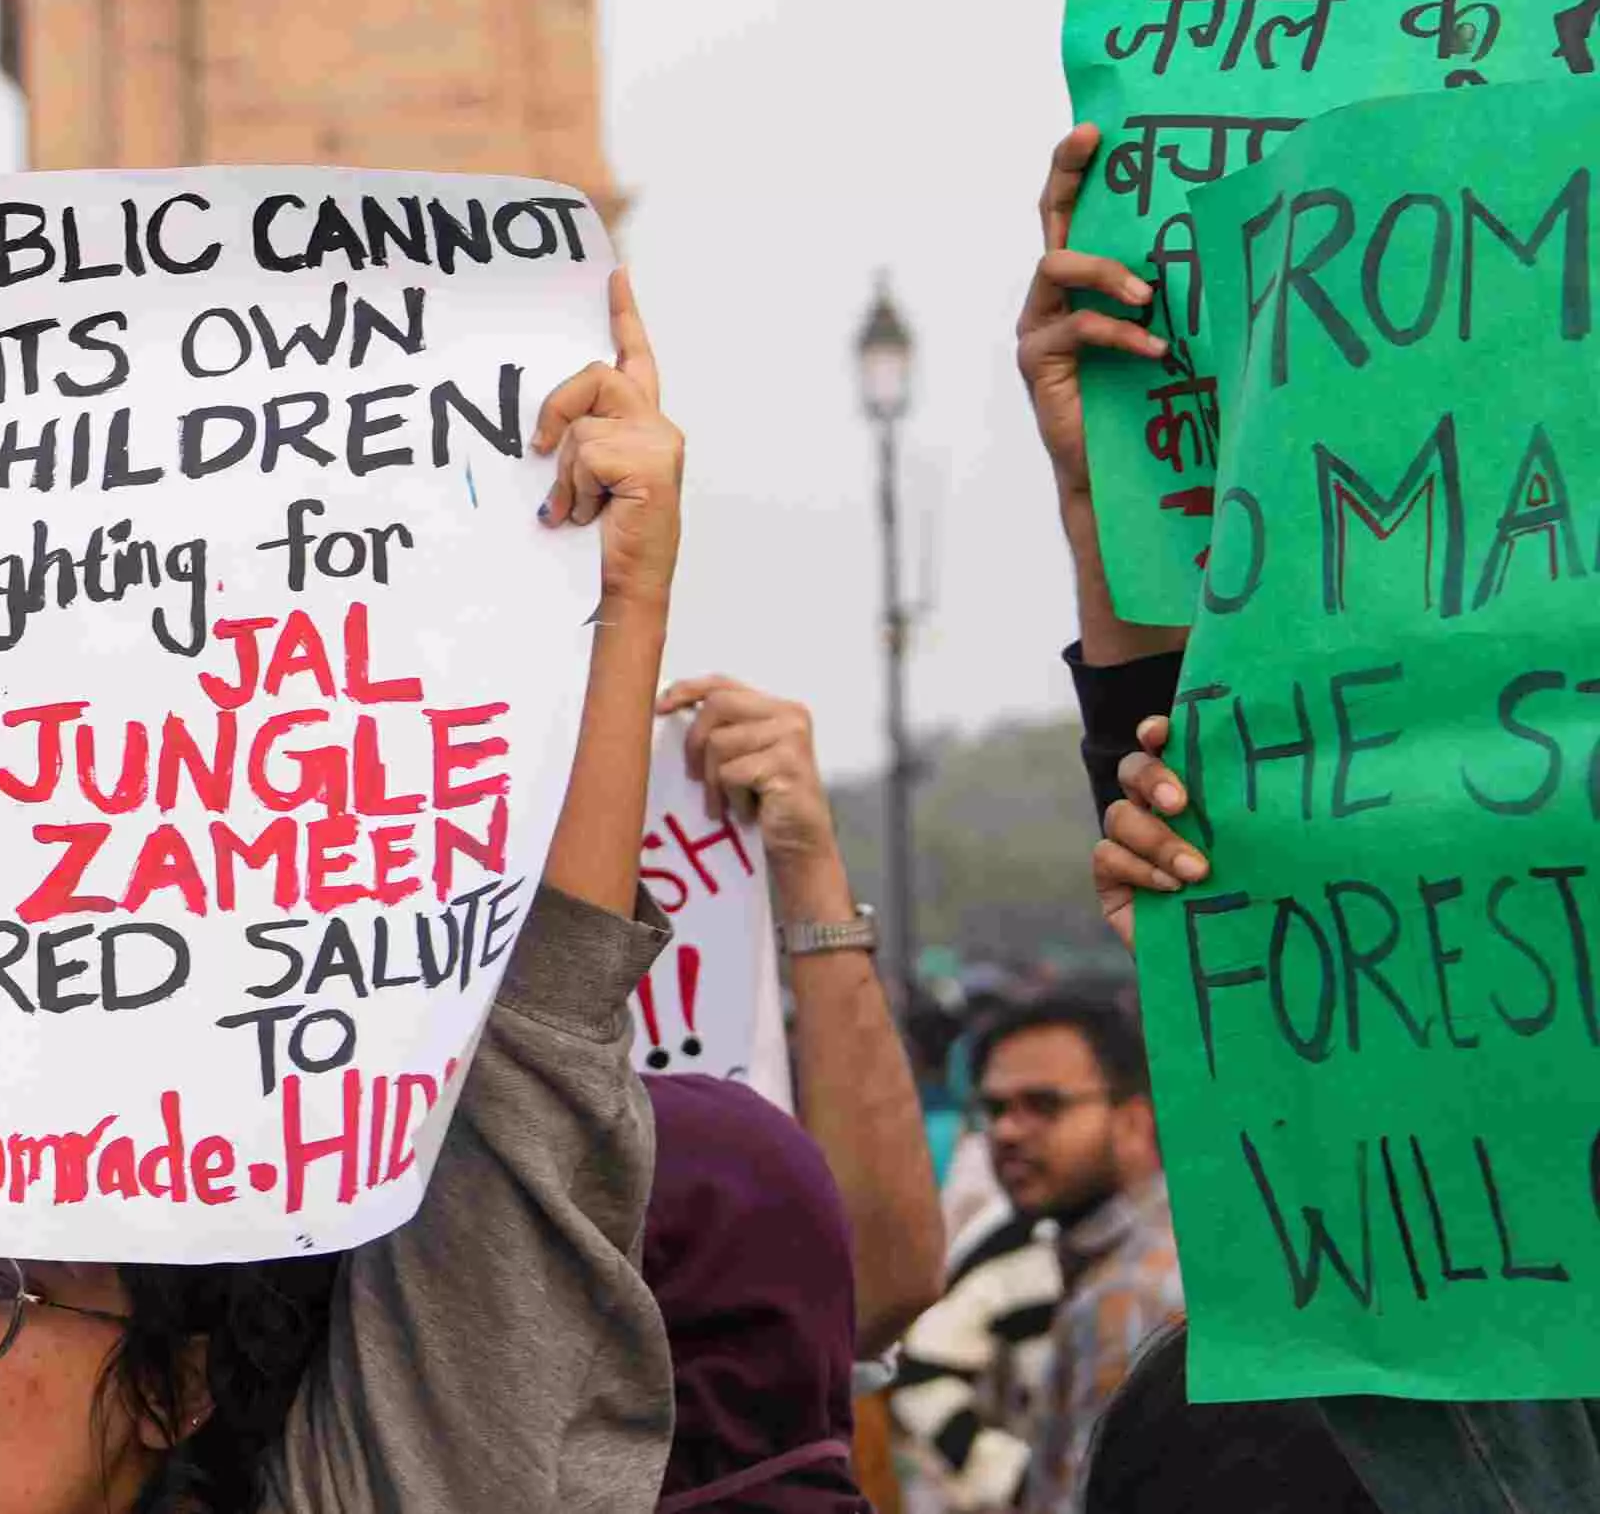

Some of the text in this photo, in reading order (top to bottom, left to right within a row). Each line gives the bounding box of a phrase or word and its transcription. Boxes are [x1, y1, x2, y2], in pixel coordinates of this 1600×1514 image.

[251, 193, 589, 274] CANNOT
[1240, 167, 1591, 389] FROM
[182, 282, 425, 378] OWN
[257, 499, 413, 591] for
[1203, 411, 1600, 619] O MA
[198, 601, 424, 709] JAL
[1176, 661, 1403, 851] THE
[16, 796, 508, 924] ZAMEEN
[245, 874, 524, 999] SALUTE
[216, 1005, 356, 1097] TO
[1240, 1130, 1571, 1314] WILL
